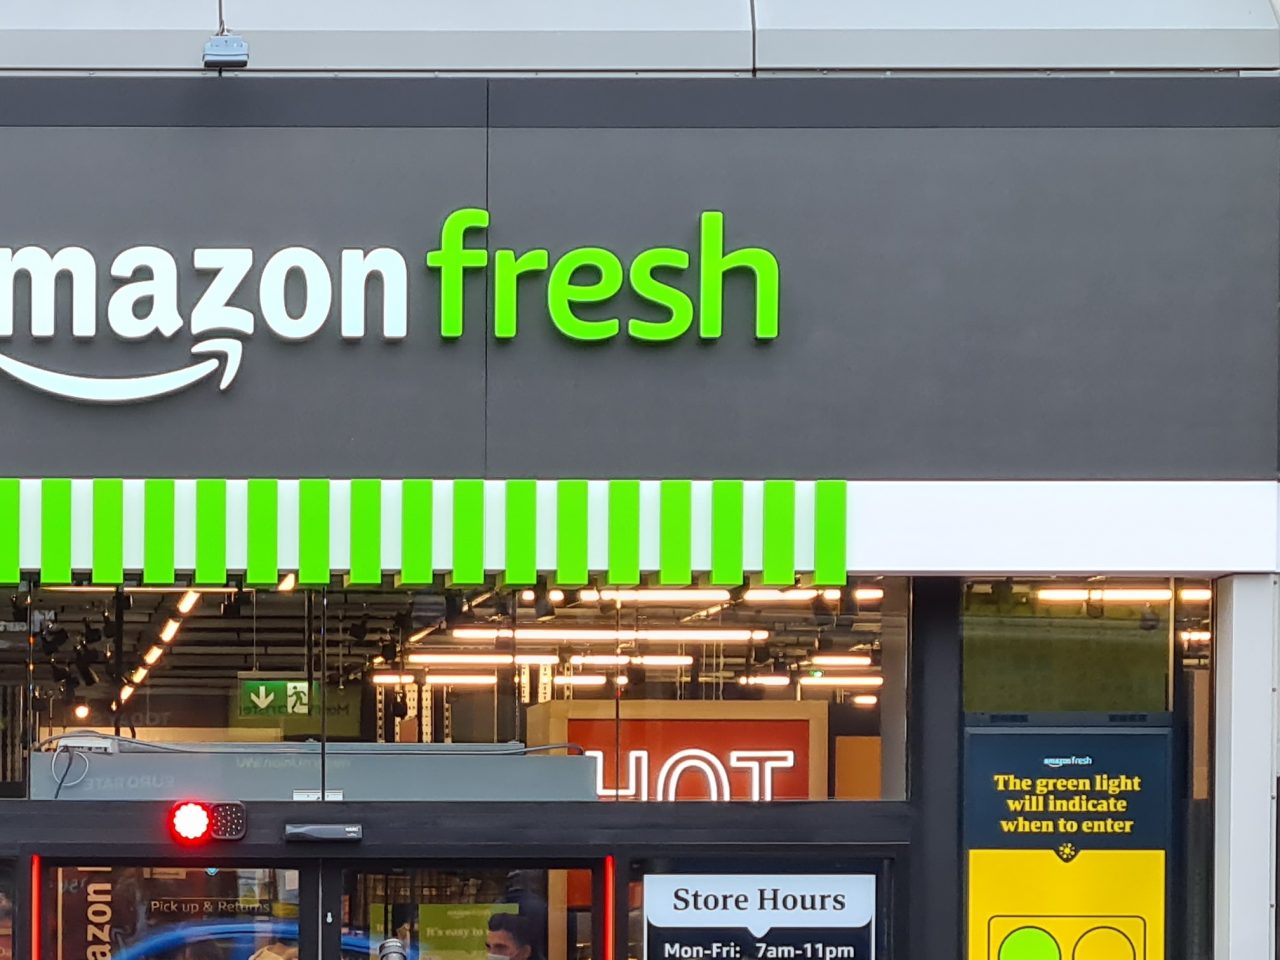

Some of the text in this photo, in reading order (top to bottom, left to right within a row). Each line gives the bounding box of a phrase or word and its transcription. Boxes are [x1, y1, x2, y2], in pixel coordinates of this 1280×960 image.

[426, 208, 781, 342] fresh
[585, 749, 794, 801] HOT
[993, 774, 1141, 794] The green light
[1006, 795, 1127, 812] will indicate
[1000, 817, 1134, 833] when to enter
[151, 901, 270, 914] Pick up & Returns
[673, 888, 846, 911] Store Hours
[664, 942, 741, 958] Mon-Fri:
